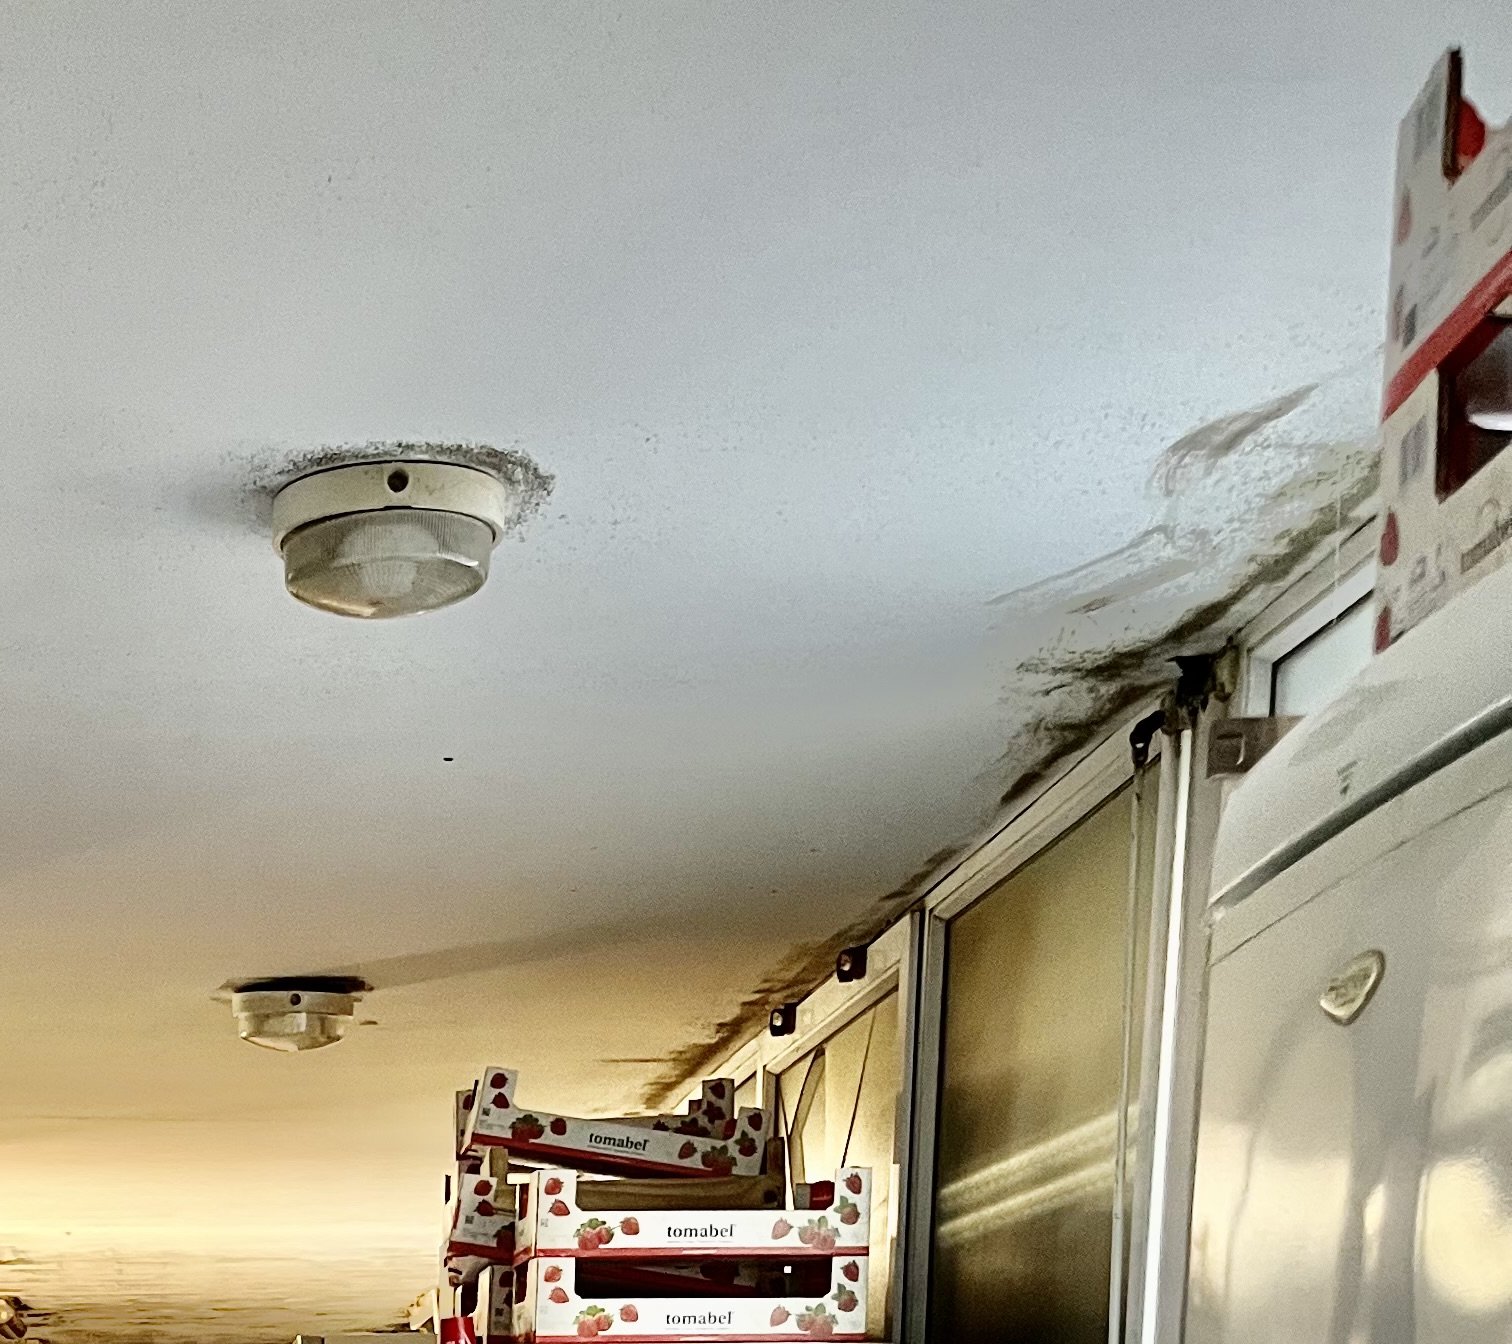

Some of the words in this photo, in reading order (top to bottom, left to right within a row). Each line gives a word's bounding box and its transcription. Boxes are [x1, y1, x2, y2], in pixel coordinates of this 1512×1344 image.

[589, 1132, 648, 1151] tomabel
[667, 1223, 734, 1238] tomabel
[666, 1310, 732, 1325] tomabel
